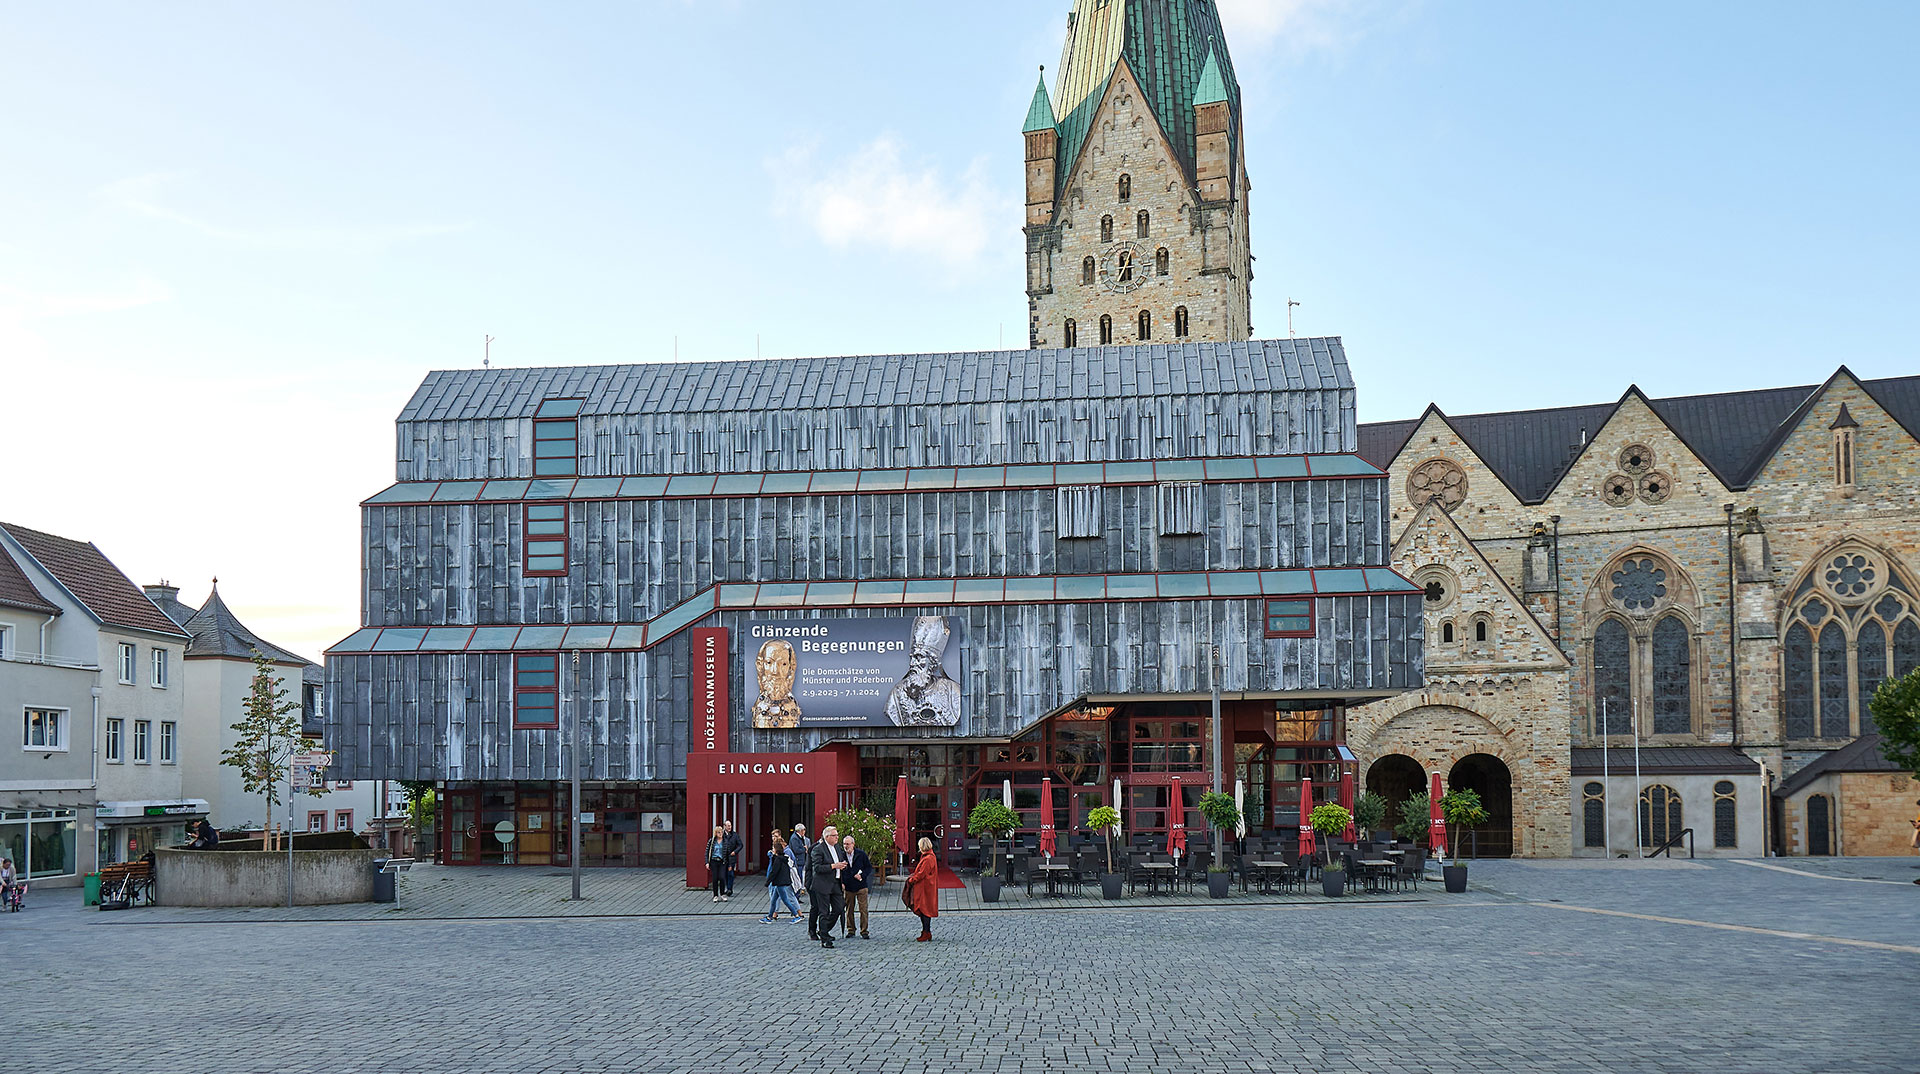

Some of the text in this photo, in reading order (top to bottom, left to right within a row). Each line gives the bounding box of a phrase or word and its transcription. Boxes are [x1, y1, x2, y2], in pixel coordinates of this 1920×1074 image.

[751, 624, 829, 638] Glänzende
[801, 640, 905, 654] Begegnungen
[802, 668, 815, 676] Die
[817, 667, 864, 675] Domschätze
[802, 676, 894, 685] Münster und Paderborn
[704, 636, 715, 750] DIÖZESANMUSEUM
[802, 689, 838, 697] 2.9.2023
[845, 689, 880, 697] 7.1.2024
[719, 763, 804, 774] EINGANG
